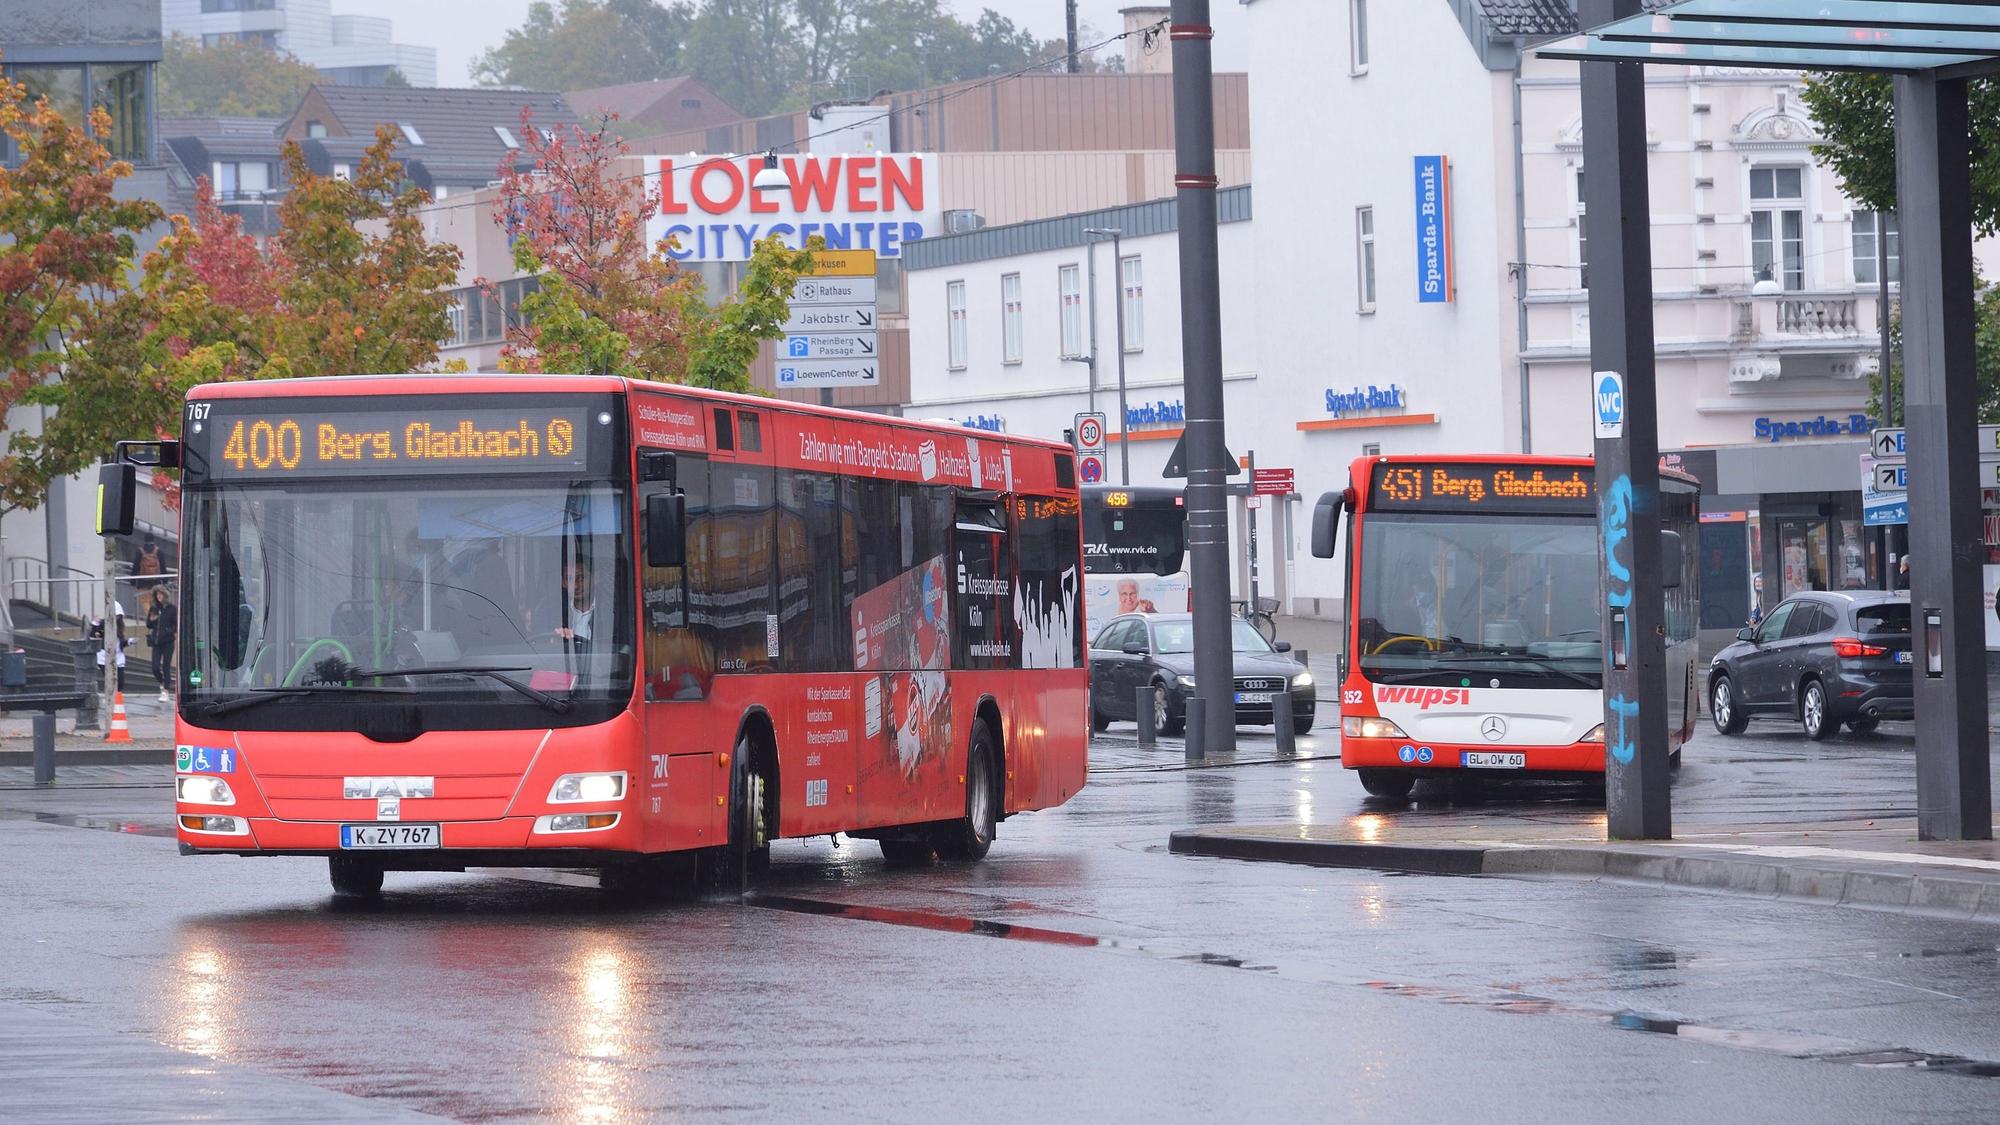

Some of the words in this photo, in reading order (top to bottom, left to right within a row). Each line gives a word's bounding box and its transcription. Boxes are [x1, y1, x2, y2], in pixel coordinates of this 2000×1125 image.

[659, 157, 924, 215] LOEWEN
[1421, 164, 1441, 294] Sparda-Bank
[819, 286, 852, 296] Rathaus
[800, 313, 852, 324] Jakobstr.
[811, 337, 854, 346] RheinBerg
[819, 346, 855, 355] Passage
[797, 369, 859, 379] LoewenCenter
[1325, 384, 1400, 418] Sparda-Bank
[1599, 392, 1621, 413] WC
[188, 403, 211, 420] 767
[1084, 426, 1097, 439] 30
[224, 420, 302, 469] 400
[406, 419, 538, 459] Gladbach
[799, 432, 827, 461] Zahlen
[827, 436, 842, 464] wie
[843, 438, 857, 466] mit
[857, 440, 889, 475] Bargeld:
[889, 444, 920, 473] Stadion-
[1381, 468, 1422, 500] 451
[1494, 470, 1588, 497] Gladbach
[1107, 492, 1128, 506] 456
[1108, 546, 1158, 554] www.rvk.de
[968, 573, 1009, 600] Kreissparkasse
[870, 611, 901, 638] Kreissparkasse
[969, 605, 983, 627] Köln
[969, 640, 1011, 657] www.ksk-koeln.de
[312, 680, 342, 688] MAN
[1344, 690, 1362, 704] 352
[1469, 755, 1483, 765] GL
[1491, 755, 1505, 765] OW
[1509, 755, 1522, 765] 60
[356, 828, 366, 845] K
[377, 828, 397, 844] ZY
[401, 827, 431, 844] 767
